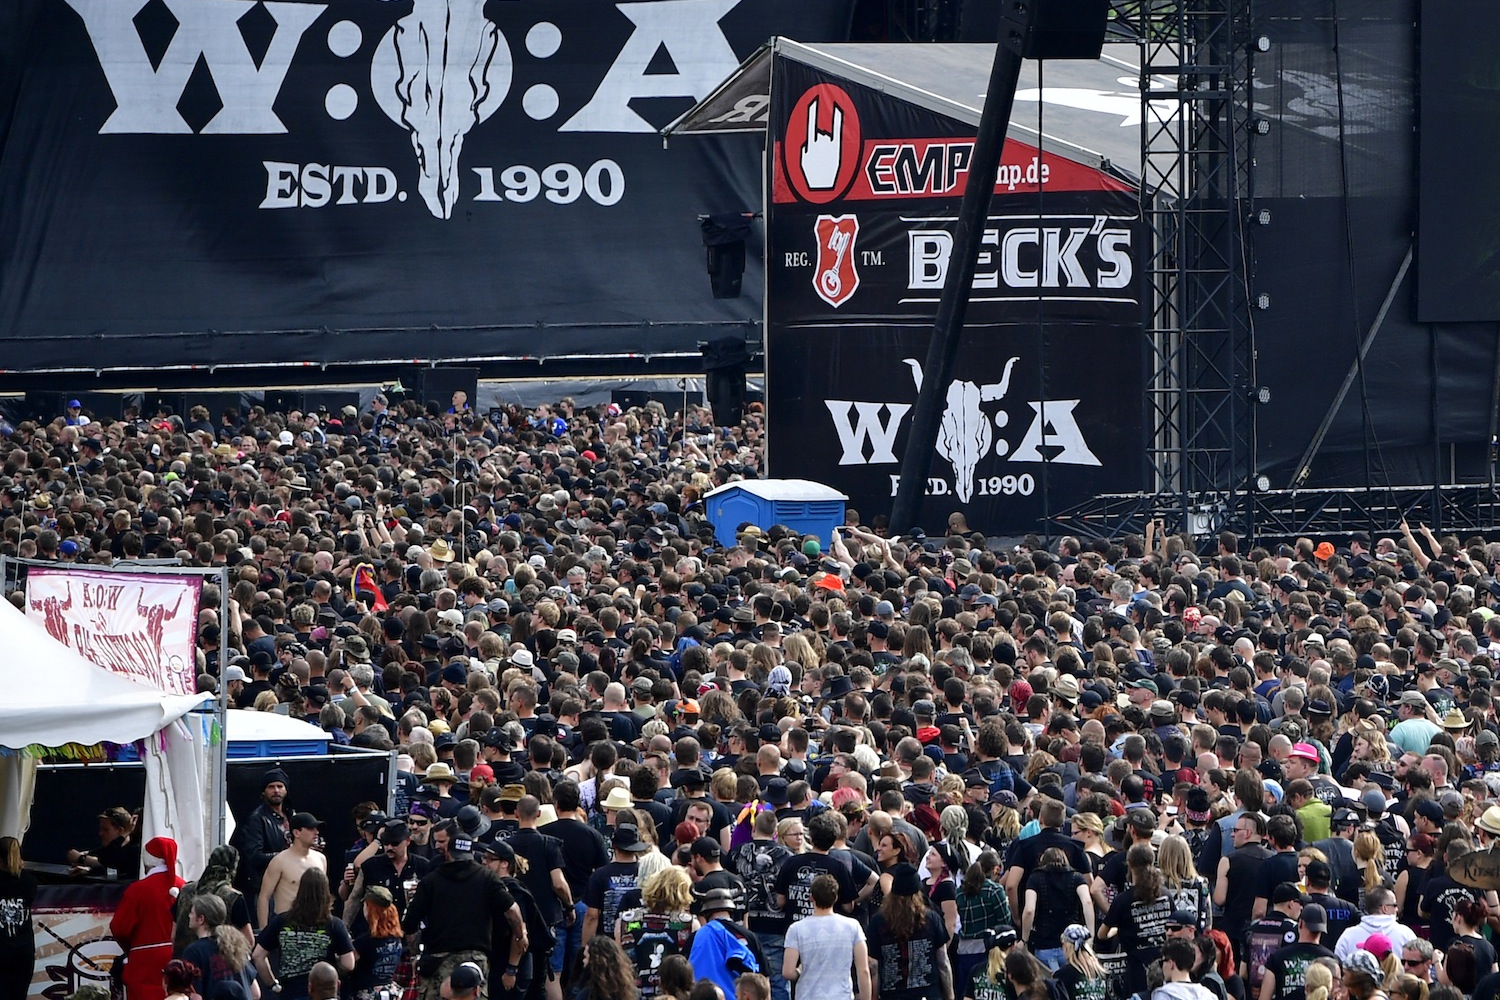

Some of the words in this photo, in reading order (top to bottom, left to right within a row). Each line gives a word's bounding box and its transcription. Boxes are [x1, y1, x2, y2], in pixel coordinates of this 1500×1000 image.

[865, 143, 977, 195] EMP
[258, 160, 408, 209] ESTD.
[472, 158, 626, 206] 1990
[784, 251, 812, 267] REG.
[861, 250, 886, 267] TM.
[907, 215, 1133, 290] BECK'S
[978, 473, 1035, 497] 1990
[1326, 908, 1351, 920] TER
[1285, 974, 1305, 987] BLAS
